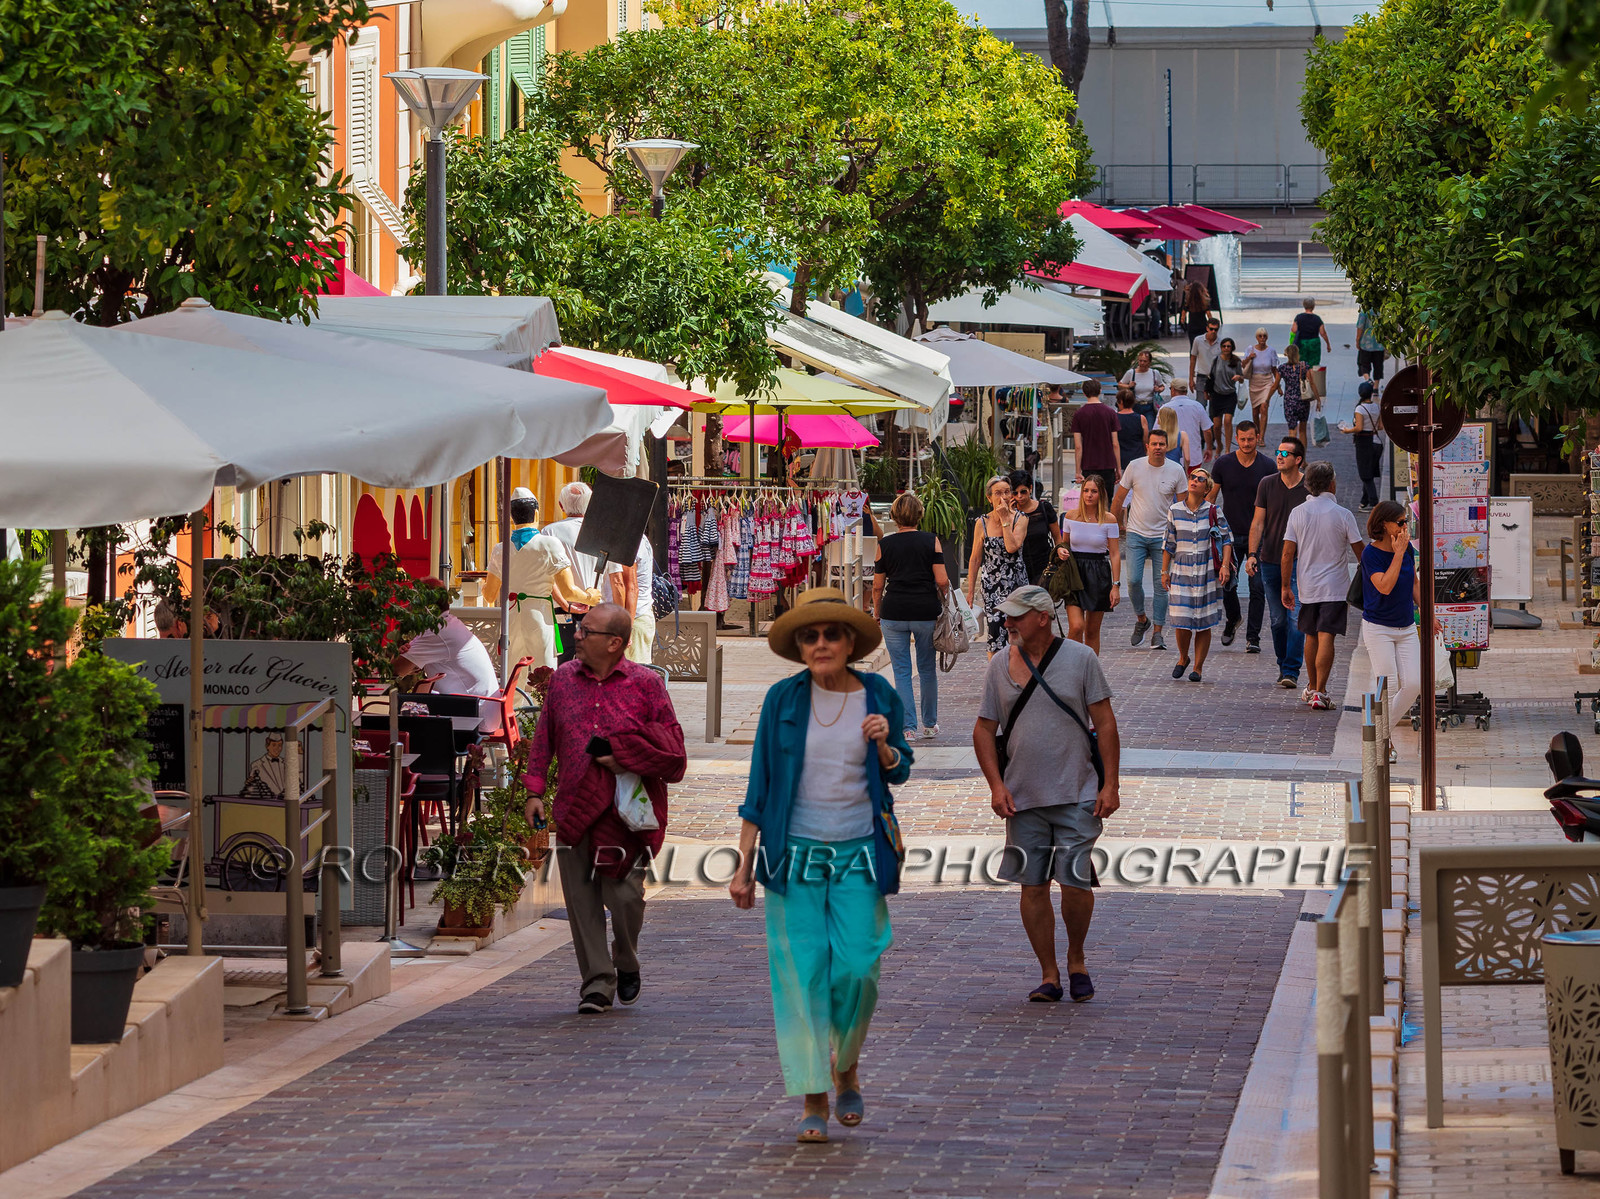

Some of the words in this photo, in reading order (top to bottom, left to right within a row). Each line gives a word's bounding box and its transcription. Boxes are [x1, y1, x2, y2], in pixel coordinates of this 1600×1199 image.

[228, 653, 258, 675] du
[255, 656, 339, 696] Glacier
[203, 684, 250, 696] MONACO
